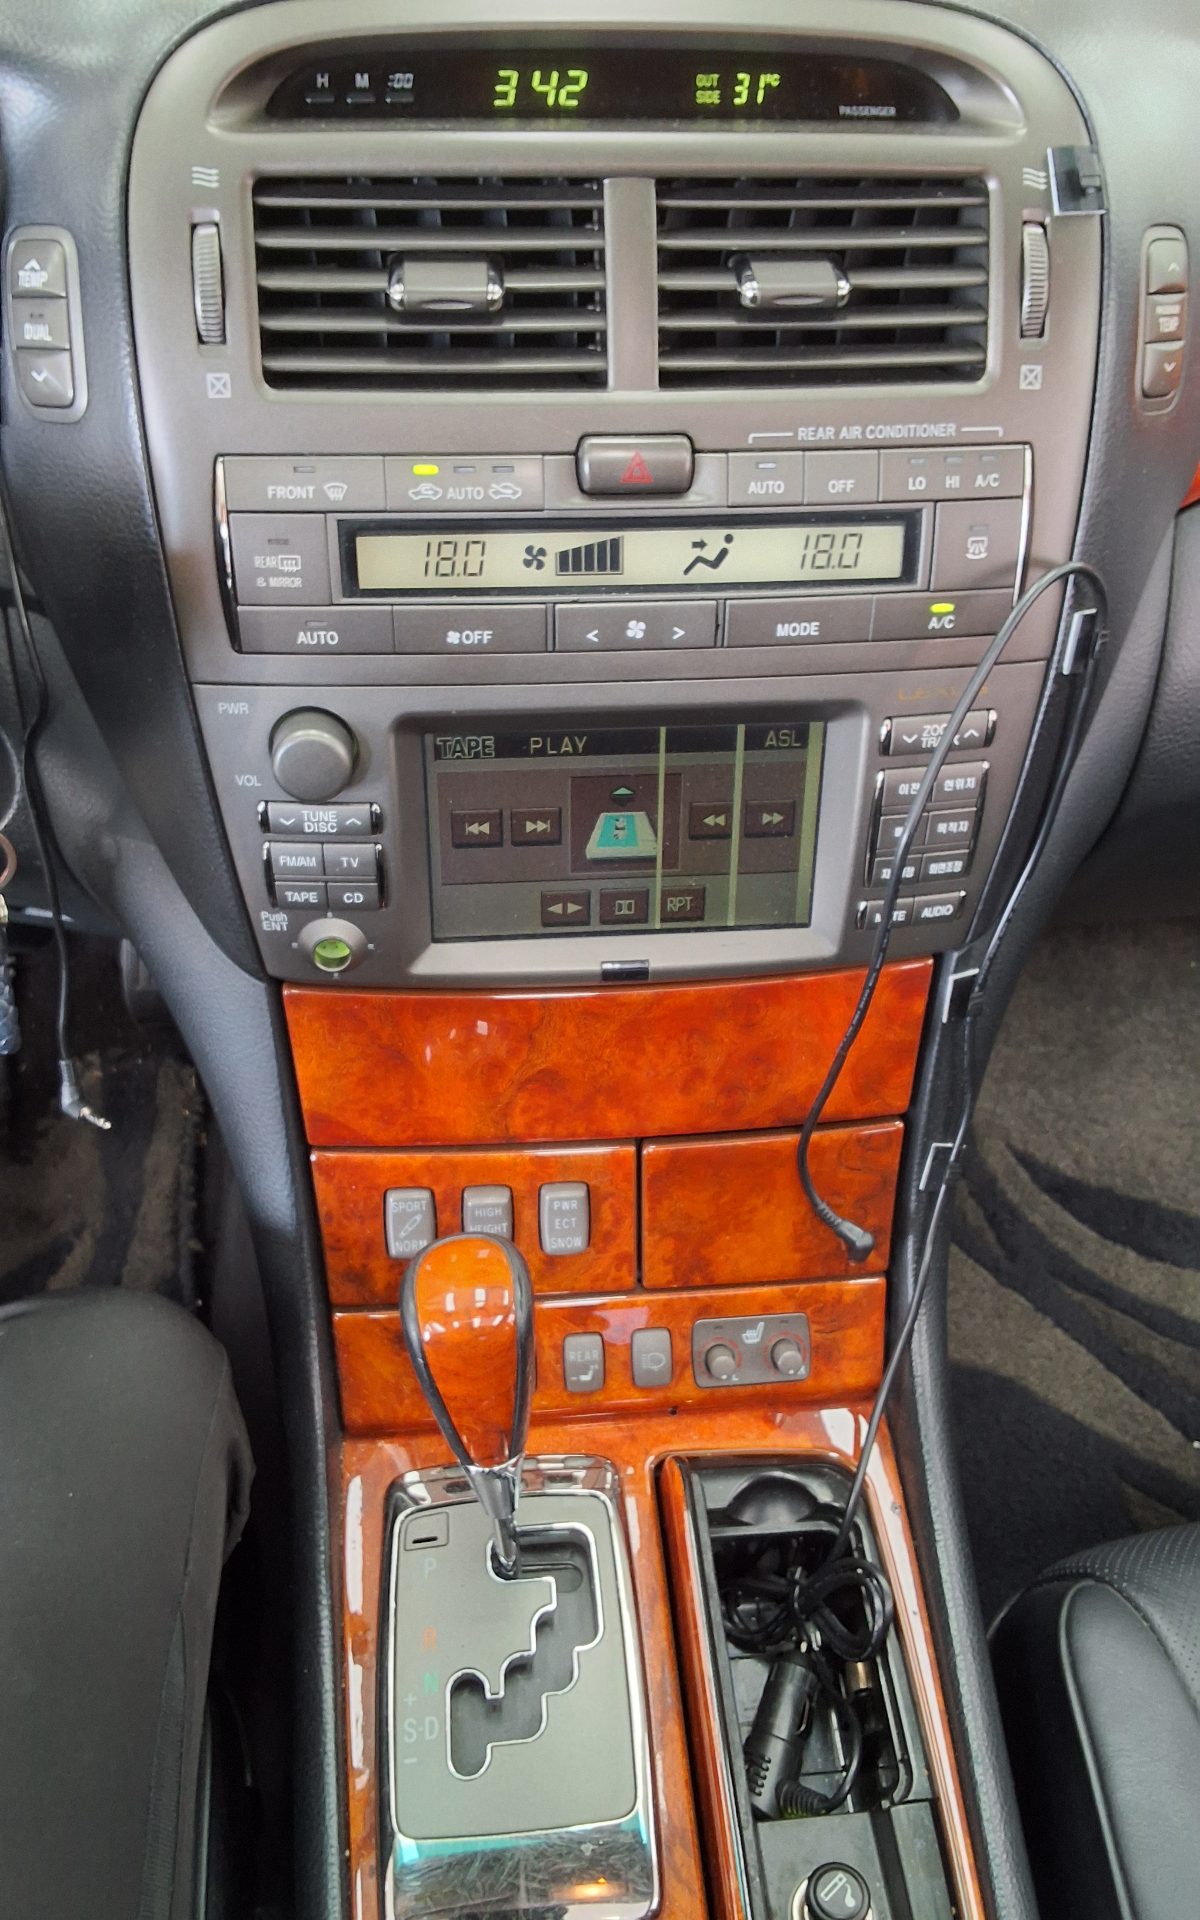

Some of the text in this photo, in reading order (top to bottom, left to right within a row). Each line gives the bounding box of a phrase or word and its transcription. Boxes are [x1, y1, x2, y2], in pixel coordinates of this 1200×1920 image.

[316, 73, 329, 88] H
[355, 73, 369, 89] M
[696, 73, 720, 87] OUT
[797, 423, 957, 441] REAR AIR CONDITIONER
[748, 480, 785, 495] AUTO
[828, 479, 856, 493] OFF
[908, 476, 927, 490] LO
[945, 475, 960, 489] HI
[974, 473, 1000, 488] A/C
[267, 485, 315, 500] FRONT
[447, 486, 485, 501] AUTO
[800, 532, 864, 570] 18.0
[424, 540, 486, 577] 18.0
[776, 621, 820, 637] MODE
[928, 614, 955, 630] A/C
[297, 631, 339, 646] AUTO
[462, 630, 493, 645] OFF
[218, 702, 249, 715] PWR
[764, 729, 801, 748] ASL
[436, 734, 588, 760] TAPE PLAY
[235, 774, 262, 787] VOL
[302, 810, 338, 822] TUNE
[303, 821, 338, 833] DISC
[279, 855, 317, 867] FM/AM
[340, 857, 359, 868] TV
[284, 891, 319, 904] TAPE
[342, 892, 364, 904] CD
[667, 896, 693, 912] RPT
[260, 911, 288, 922] Push
[920, 903, 954, 919] AUDIO
[263, 921, 289, 932] ENT
[391, 1201, 428, 1213] SPORT
[474, 1207, 503, 1217] HIGH
[553, 1200, 578, 1211] PWR
[554, 1218, 577, 1229] ECT
[551, 1237, 582, 1249] SNOW
[569, 1350, 598, 1362] REAR
[423, 1557, 437, 1580] P
[422, 1626, 438, 1653] R
[423, 1671, 438, 1696] N
